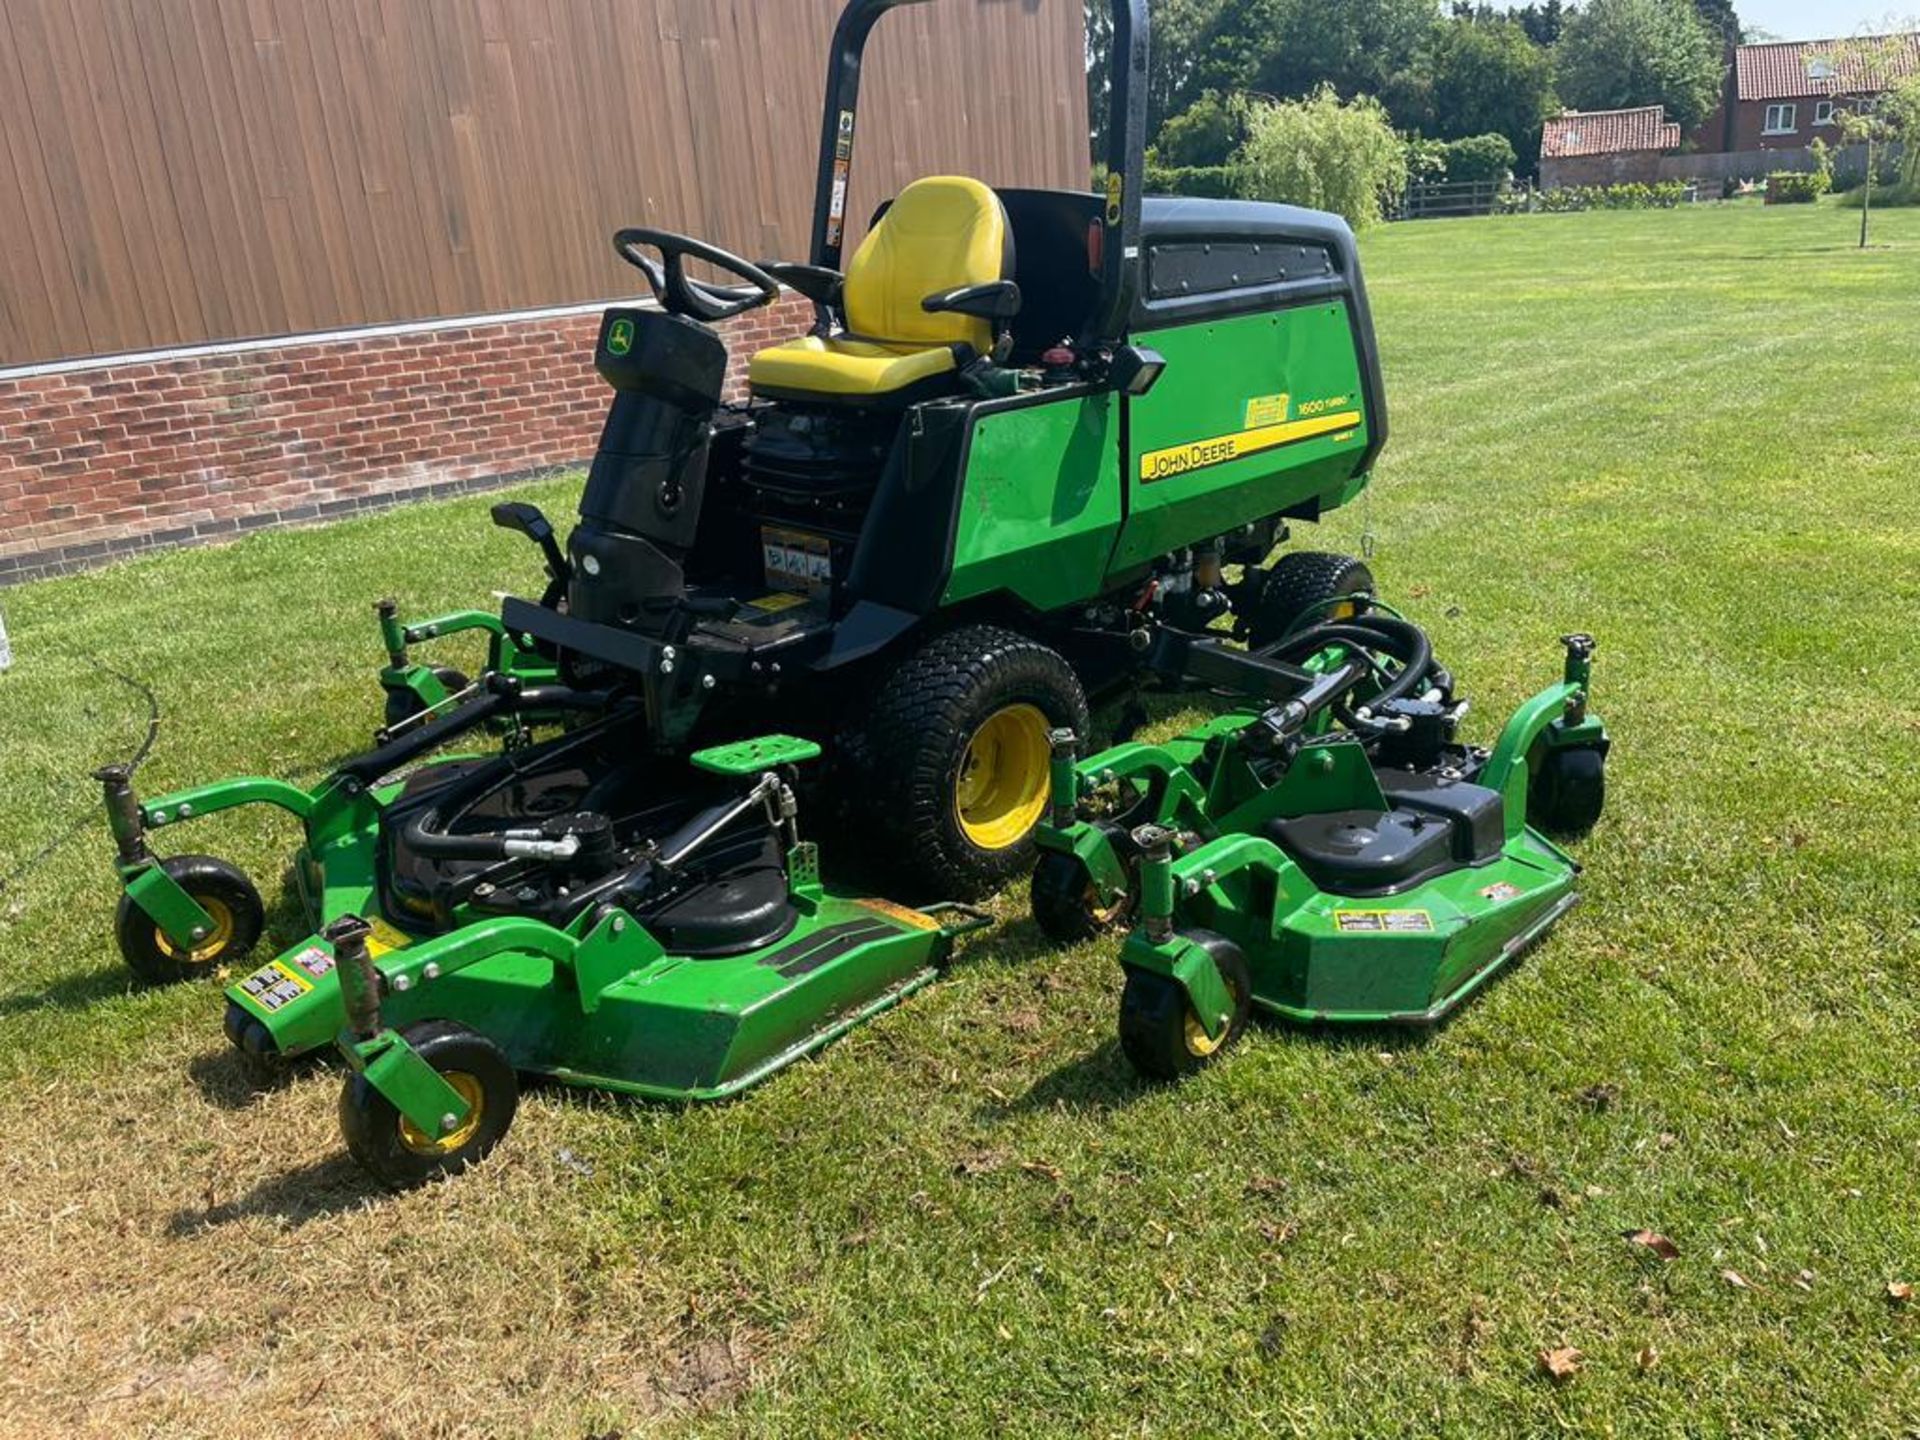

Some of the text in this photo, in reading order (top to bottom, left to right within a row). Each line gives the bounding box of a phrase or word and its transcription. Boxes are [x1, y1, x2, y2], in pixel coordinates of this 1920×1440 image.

[1299, 400, 1324, 415] 1600
[1150, 440, 1235, 476] JOHN DEERE
